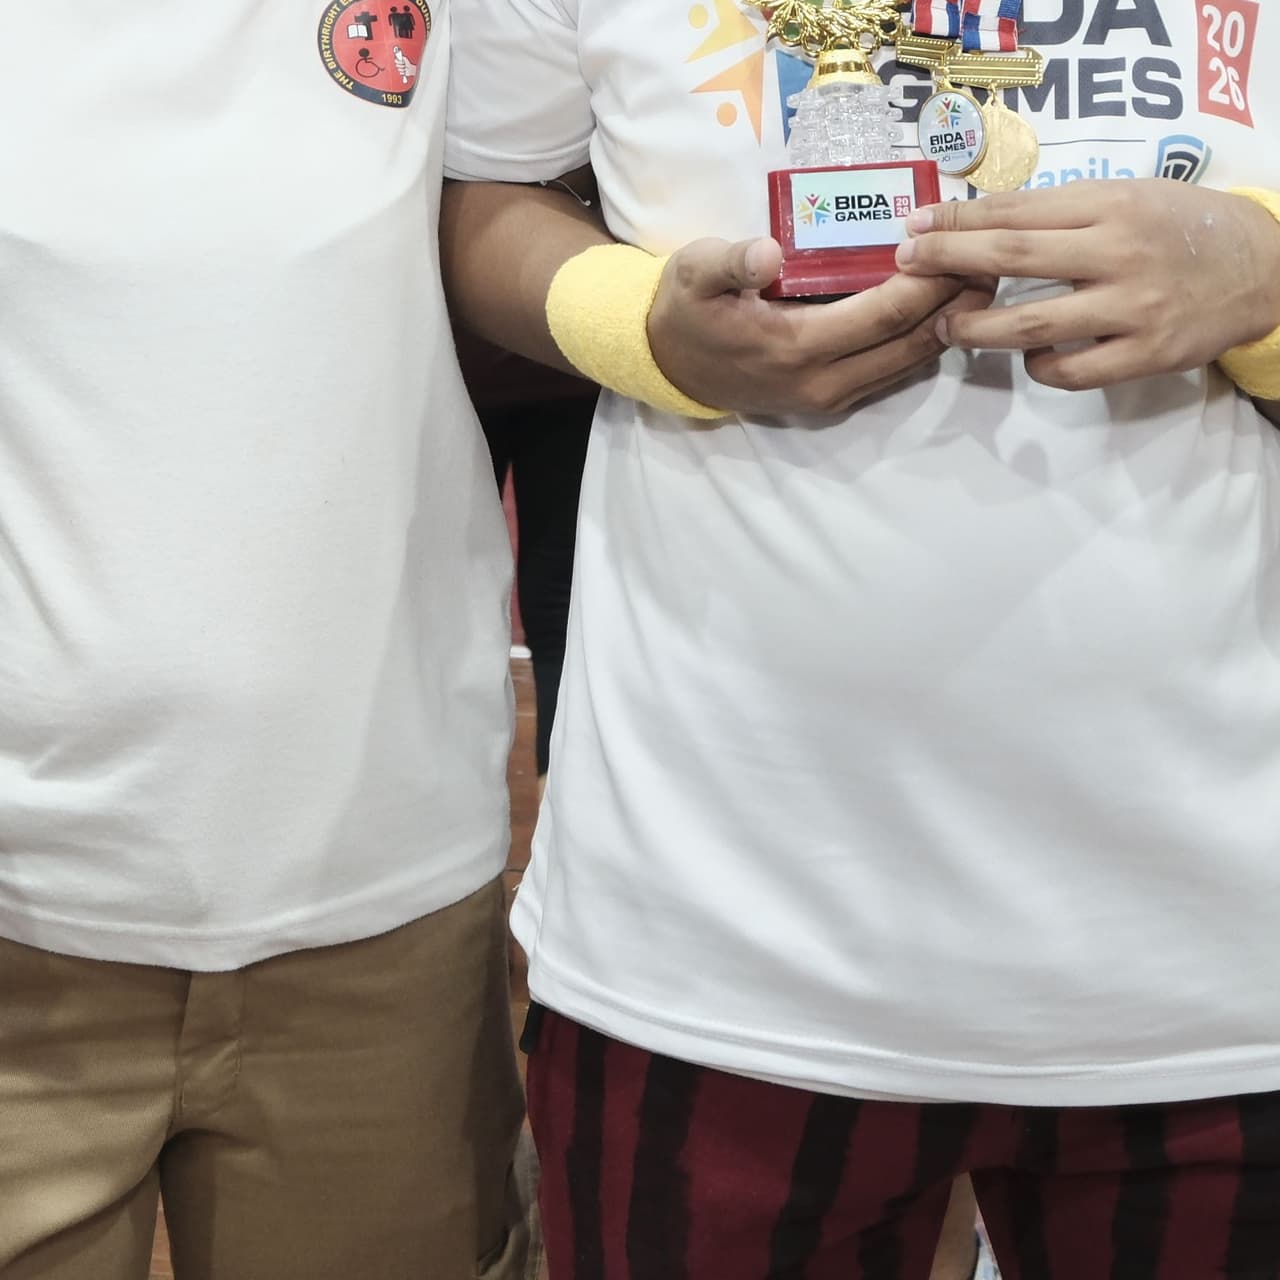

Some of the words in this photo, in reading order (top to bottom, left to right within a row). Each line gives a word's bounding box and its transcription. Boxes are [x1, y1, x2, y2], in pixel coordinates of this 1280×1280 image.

[321, 4, 342, 69] BIRTHRIGHT
[1202, 4, 1245, 58] 20
[333, 71, 355, 90] THE
[876, 56, 1184, 121] GMES
[1208, 56, 1246, 112] 26
[381, 93, 403, 105] 1993
[930, 131, 964, 146] BIDA
[930, 142, 967, 155] GAMES
[835, 194, 889, 210] BIDA
[835, 209, 892, 222] GAMES
